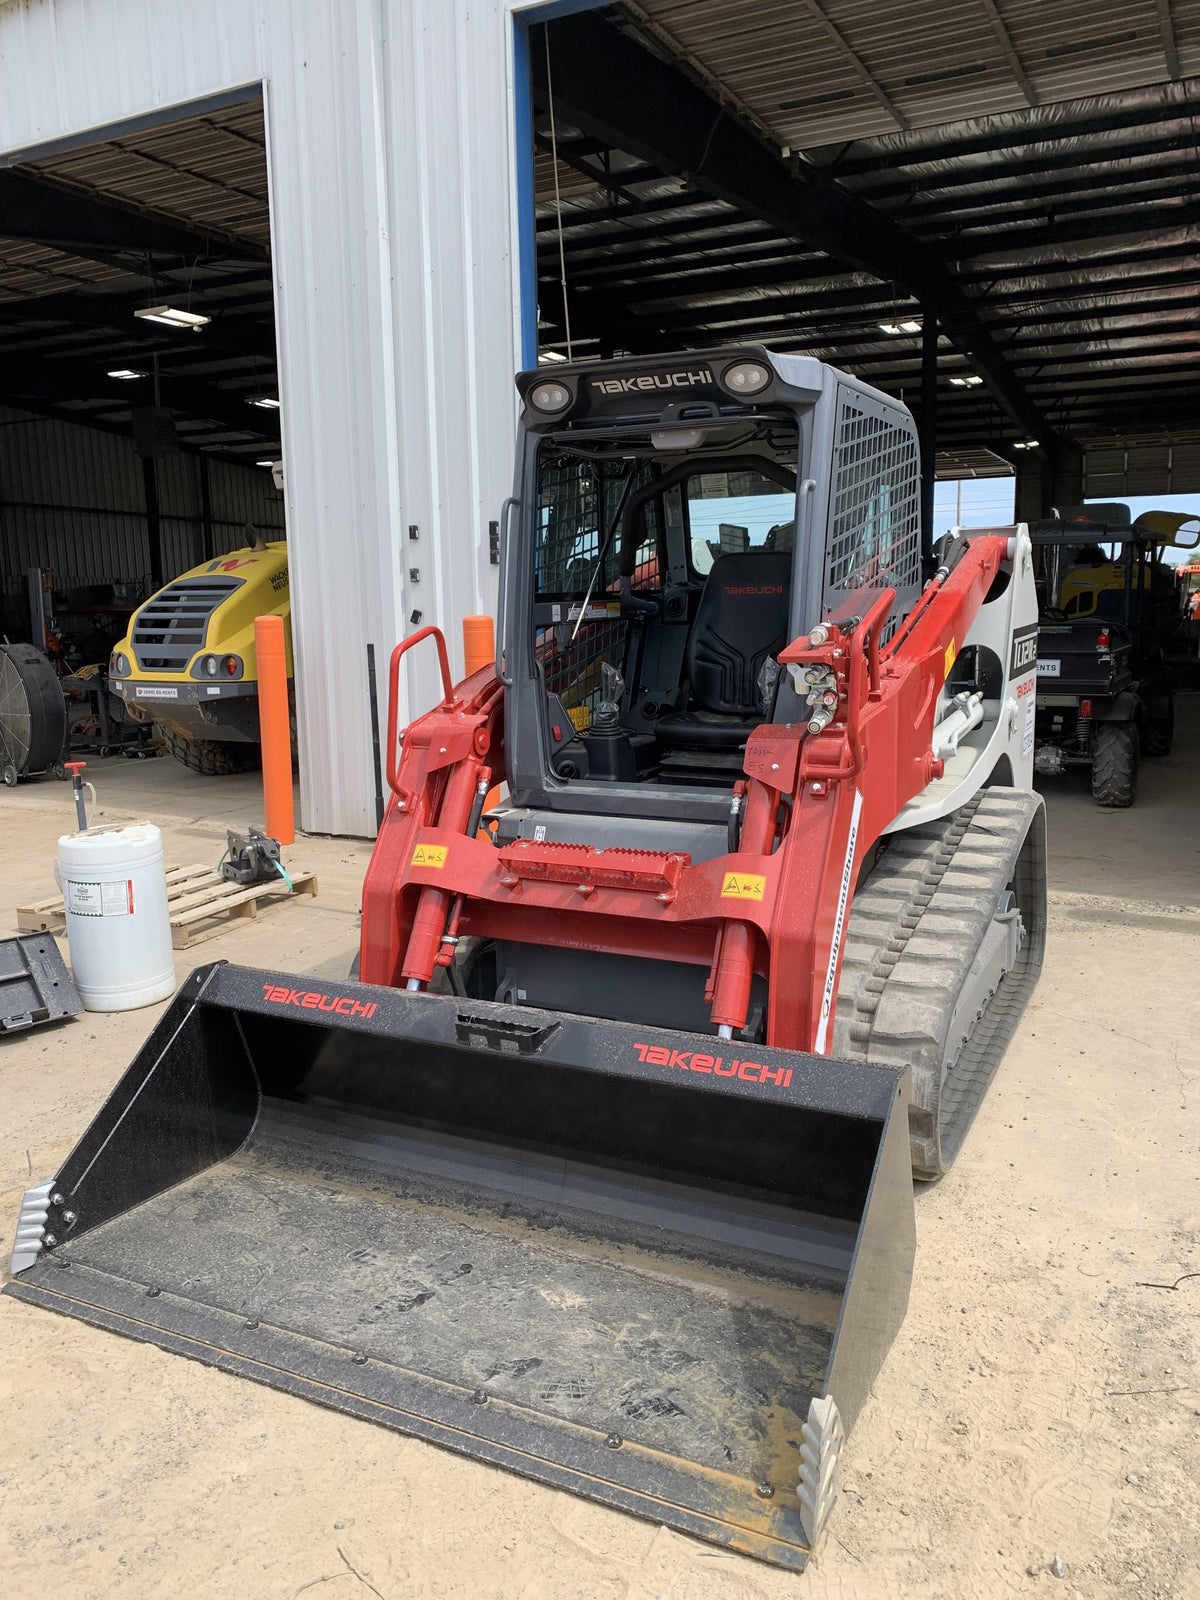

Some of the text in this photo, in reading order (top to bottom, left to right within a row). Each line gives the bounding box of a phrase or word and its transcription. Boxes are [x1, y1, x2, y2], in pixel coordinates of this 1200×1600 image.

[592, 370, 713, 394] TAKEUCHI
[826, 826, 856, 995] EquipmentShare
[263, 984, 377, 1019] TAKEUCHI
[633, 1043, 793, 1088] TAKEUCHI
